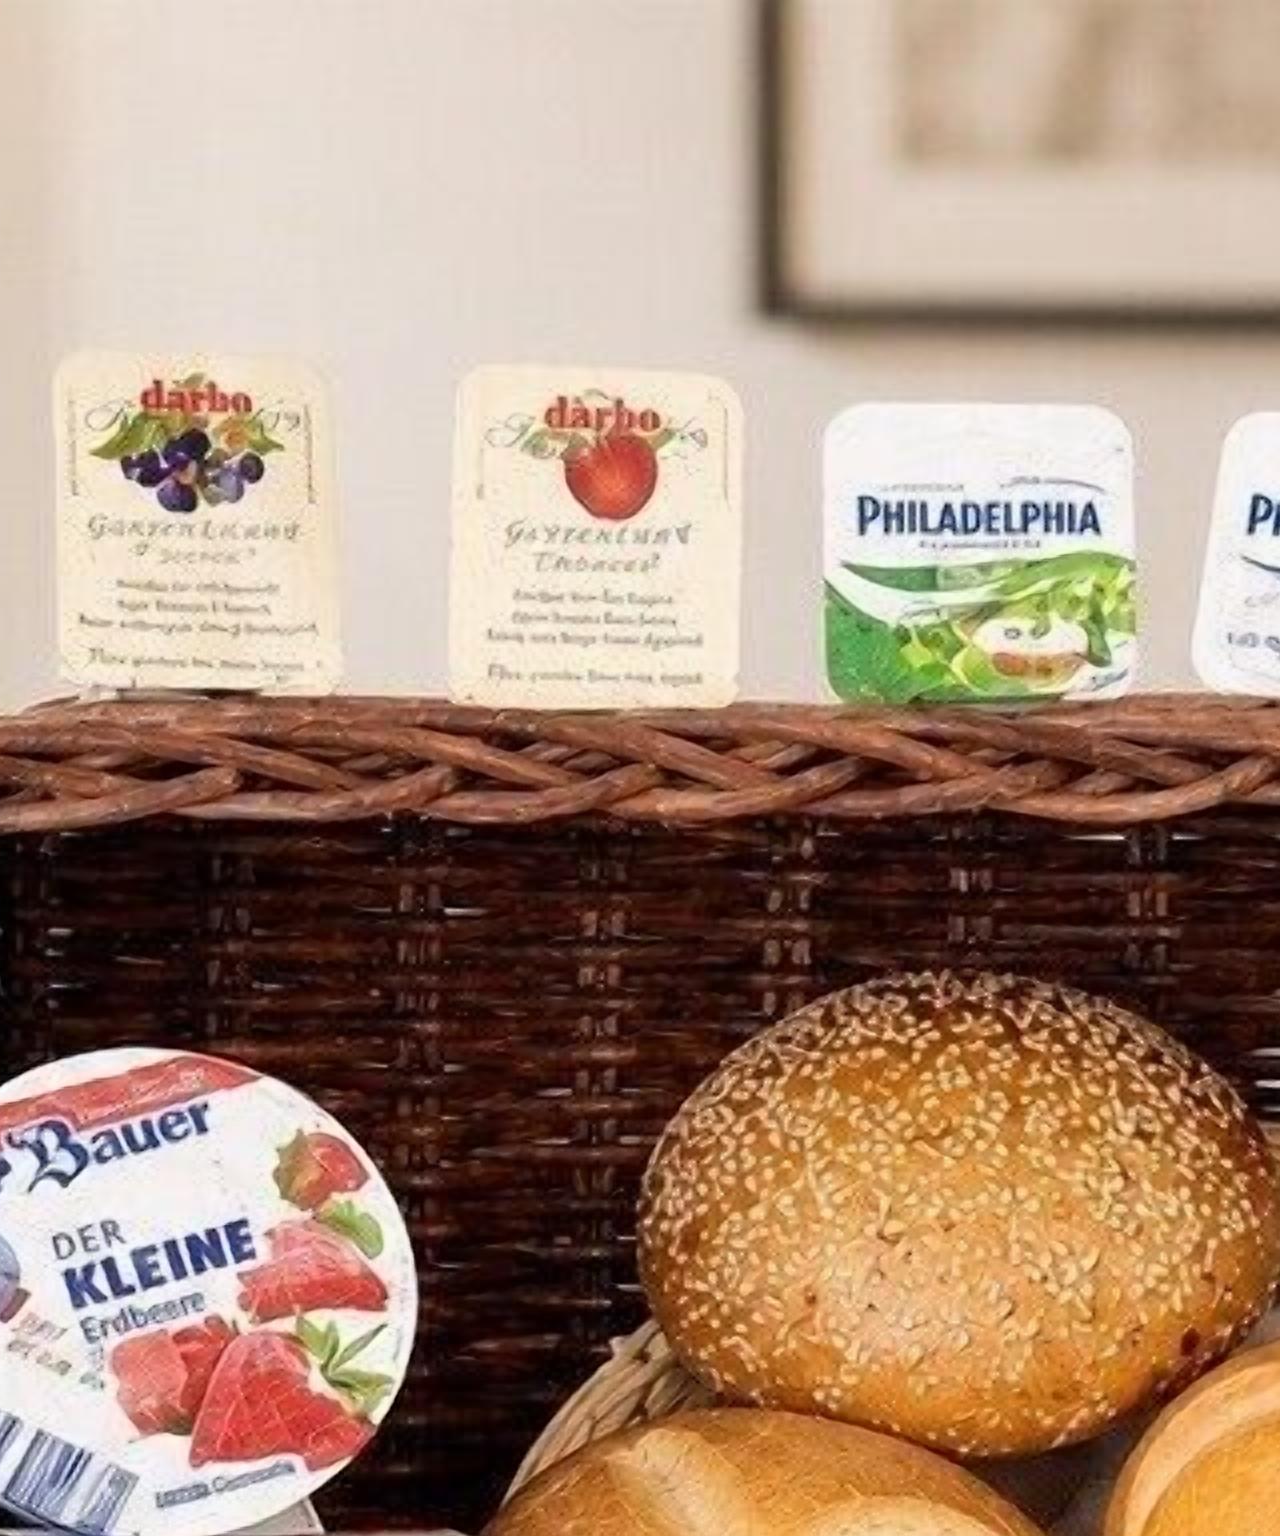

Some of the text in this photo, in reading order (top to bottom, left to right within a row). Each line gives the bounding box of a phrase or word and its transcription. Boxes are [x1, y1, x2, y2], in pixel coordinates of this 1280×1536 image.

[139, 378, 253, 414] darbo
[543, 396, 661, 433] darbo
[855, 495, 1102, 537] PHILADELPHIA
[6, 1102, 211, 1194] Bauer
[52, 1218, 127, 1261] DER
[62, 1217, 257, 1310] KLEINE
